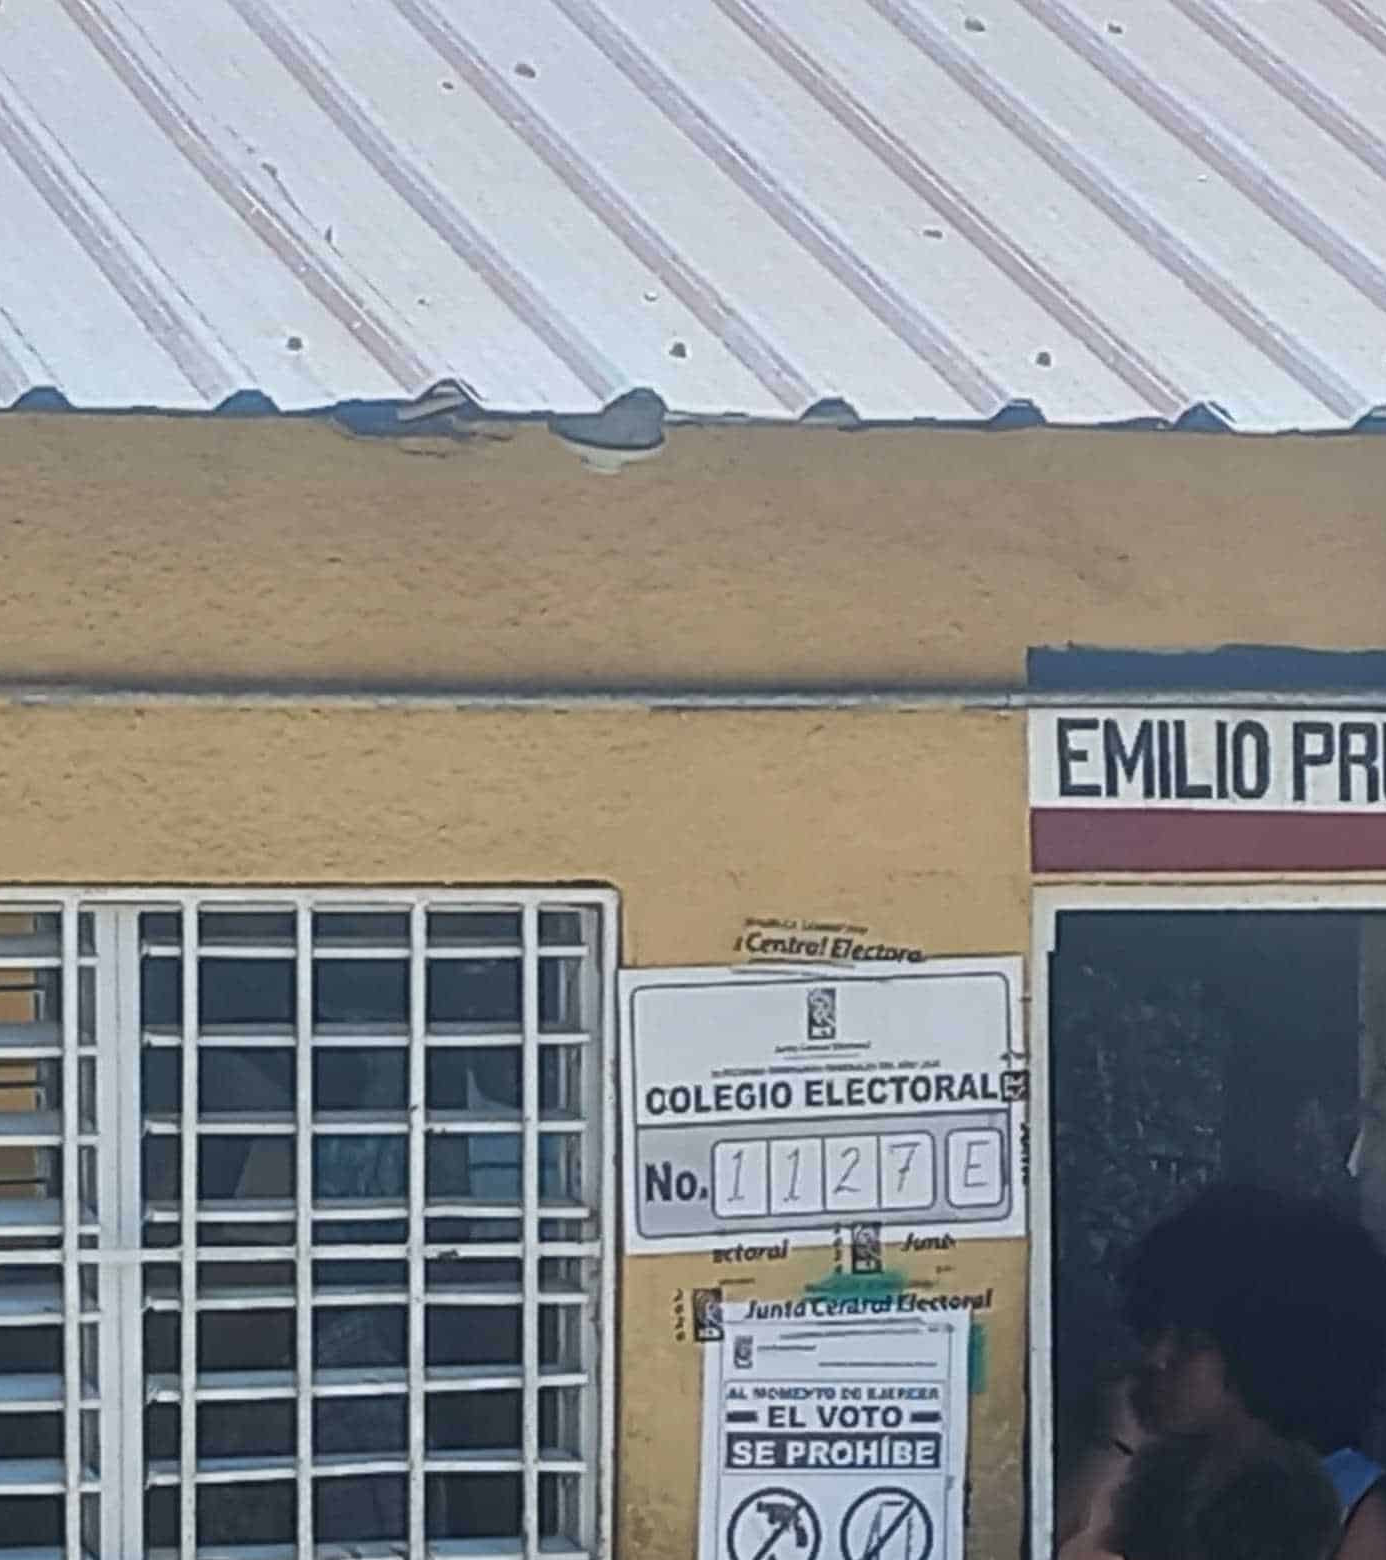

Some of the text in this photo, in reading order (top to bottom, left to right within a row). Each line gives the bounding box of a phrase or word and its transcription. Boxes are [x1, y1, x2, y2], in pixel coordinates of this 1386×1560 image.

[1057, 718, 1270, 801] EMILIO
[745, 931, 829, 957] Central
[645, 1070, 999, 1116] COLEGIO ELECTORAL
[644, 1161, 709, 1202] No.
[745, 1299, 807, 1321] Junta
[897, 1288, 994, 1312] Electoral
[767, 1405, 903, 1429] EL VOTO
[731, 1436, 936, 1466] SE PROHÍBE
